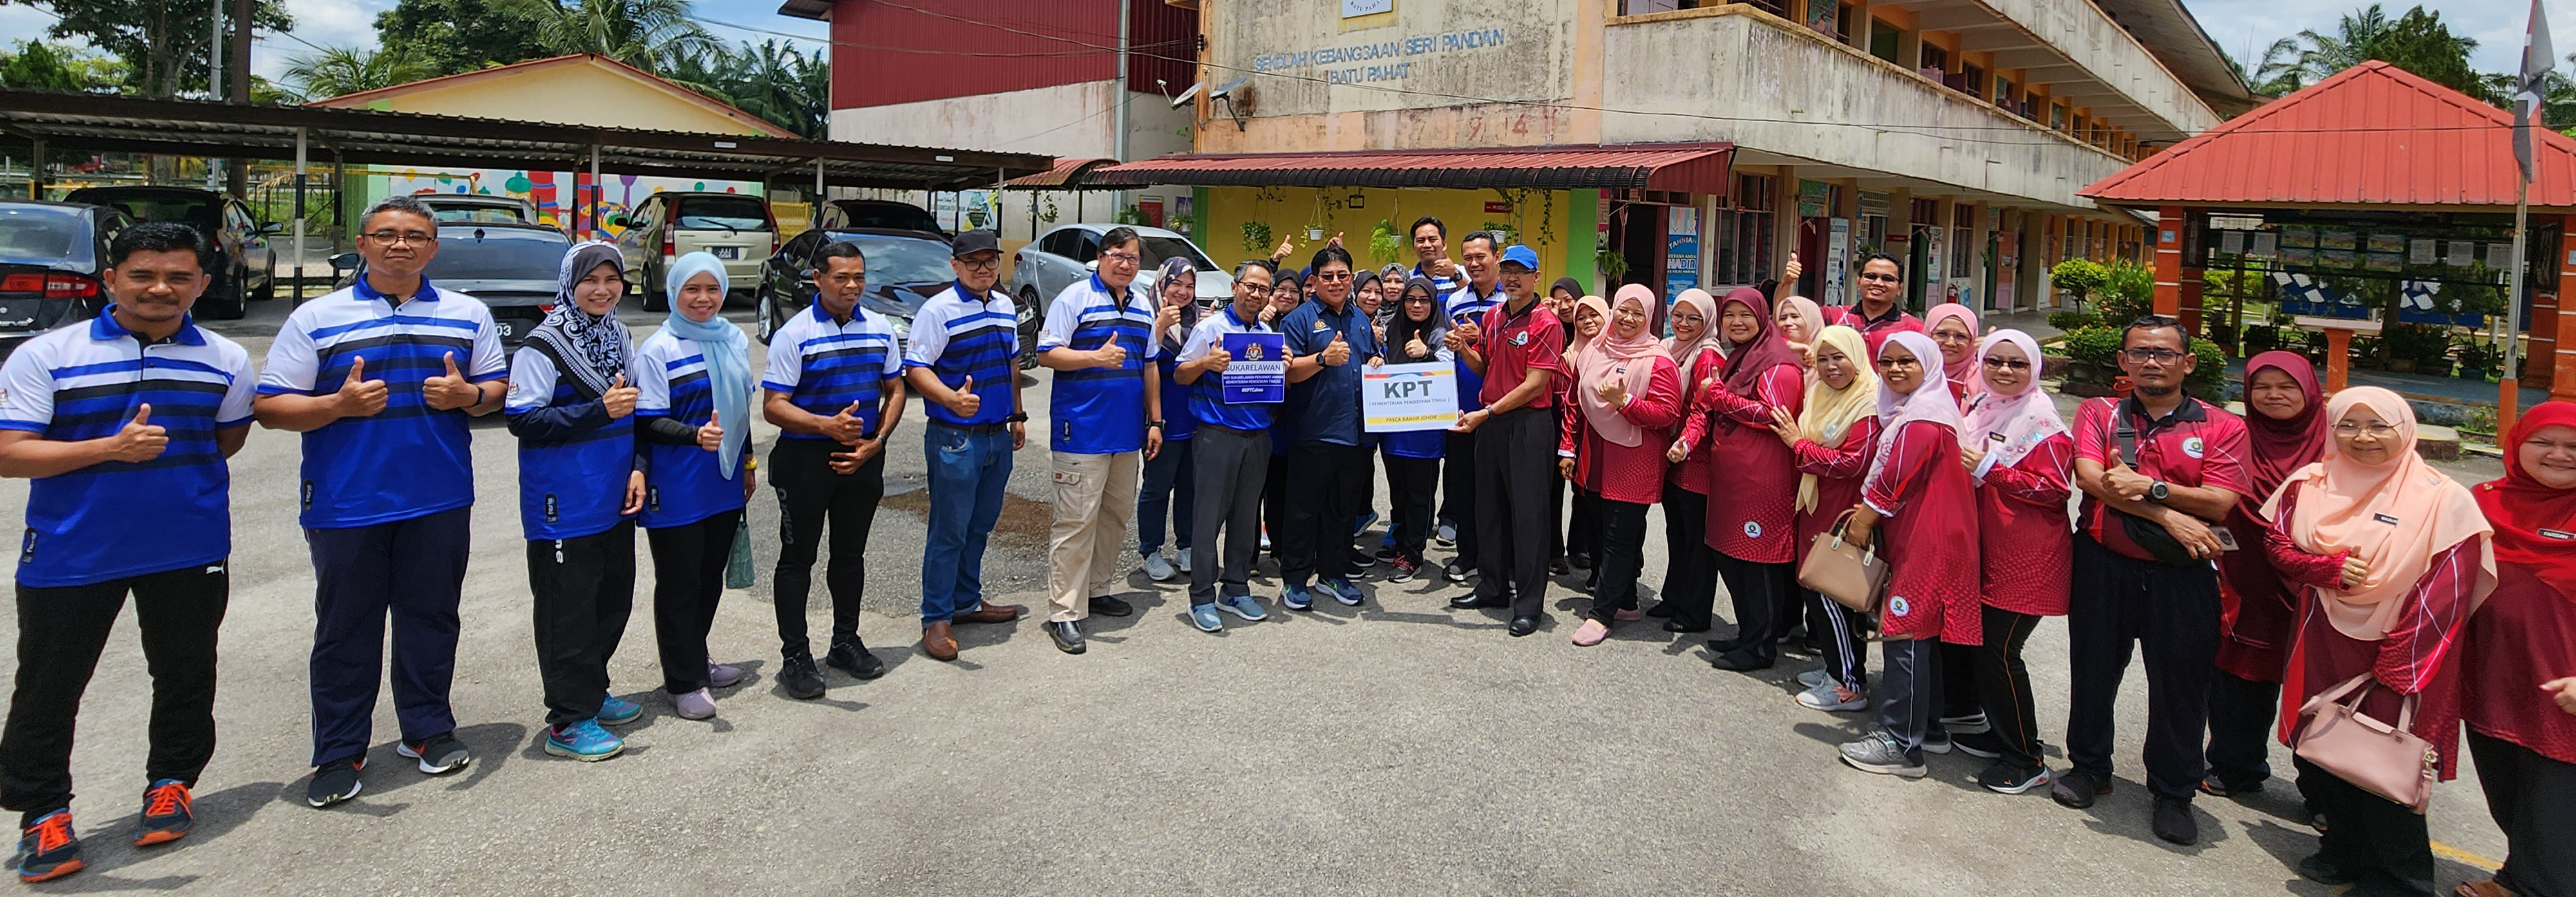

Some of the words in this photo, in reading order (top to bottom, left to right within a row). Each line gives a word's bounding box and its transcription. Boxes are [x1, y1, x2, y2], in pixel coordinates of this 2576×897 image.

[1255, 52, 1307, 71] SEKOLAH
[1309, 43, 1399, 64] KEBANGSAAN
[1405, 37, 1437, 56] SERI
[1441, 28, 1505, 52] PANDAN
[1330, 67, 1363, 84] BATU
[1367, 62, 1411, 81] PAHAT
[1669, 237, 1697, 250] TAHNIAH
[1667, 258, 1696, 269] HADIR
[1384, 380, 1433, 399] KPT
